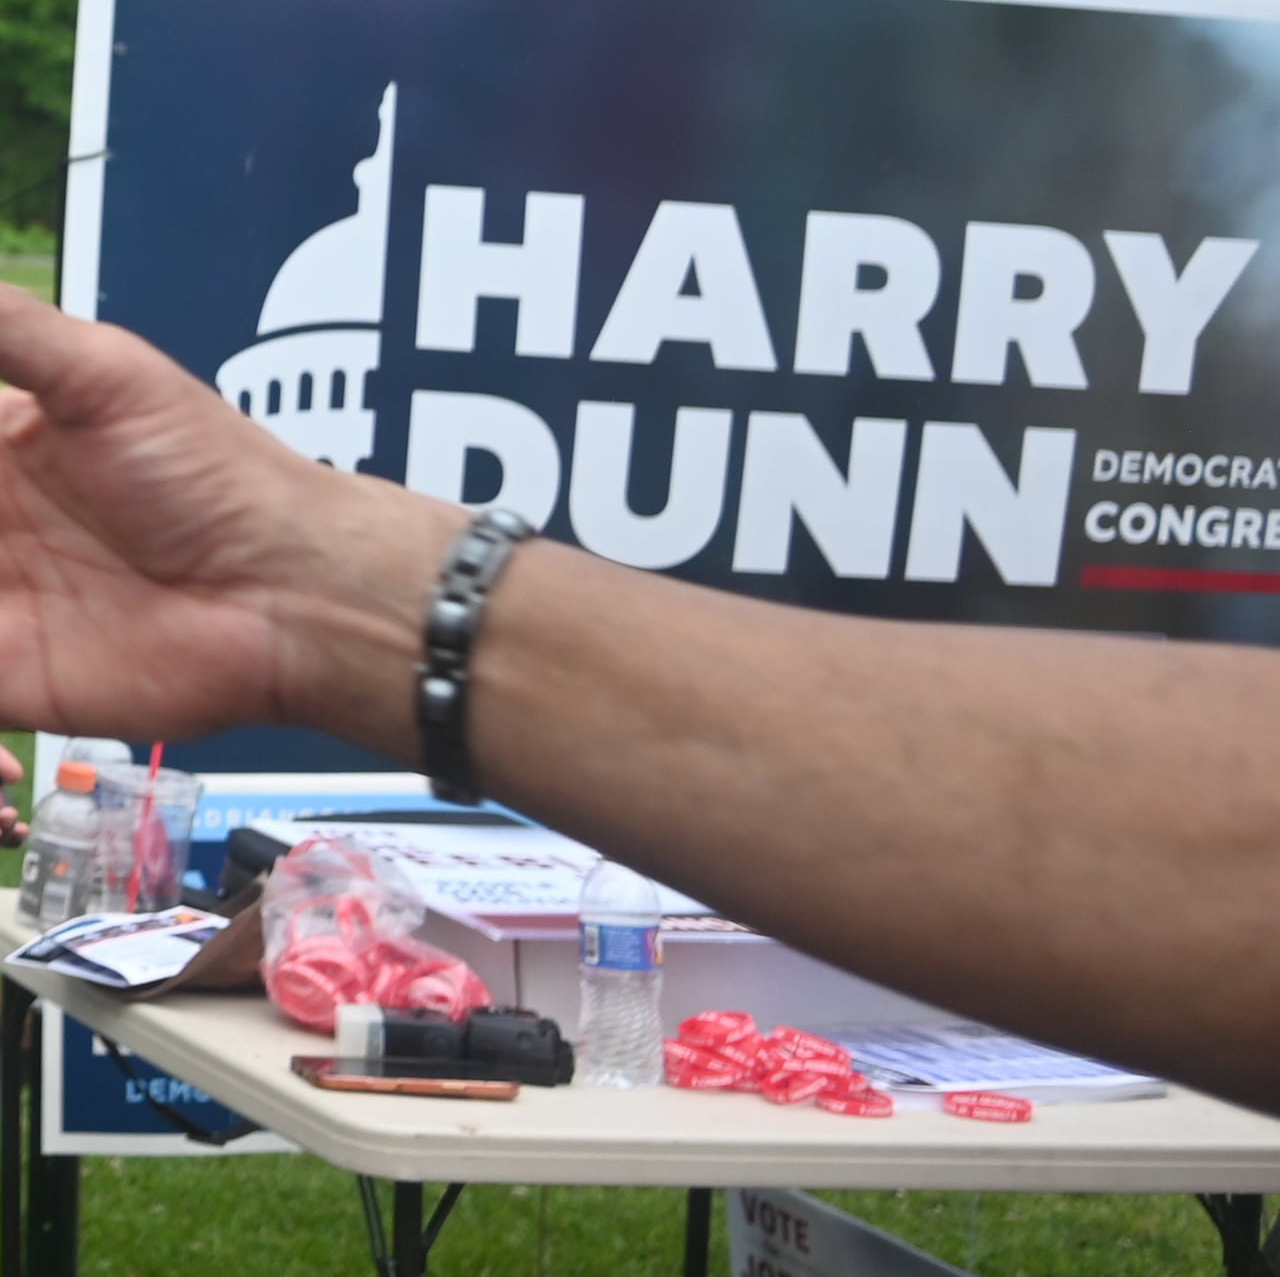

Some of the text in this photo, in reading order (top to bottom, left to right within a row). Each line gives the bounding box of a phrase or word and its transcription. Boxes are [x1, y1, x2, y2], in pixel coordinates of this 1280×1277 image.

[415, 183, 1260, 396] HARRY
[405, 389, 1077, 587] DUNN
[1092, 448, 1280, 490] DEMOCRA
[742, 1188, 811, 1255] VOTE
